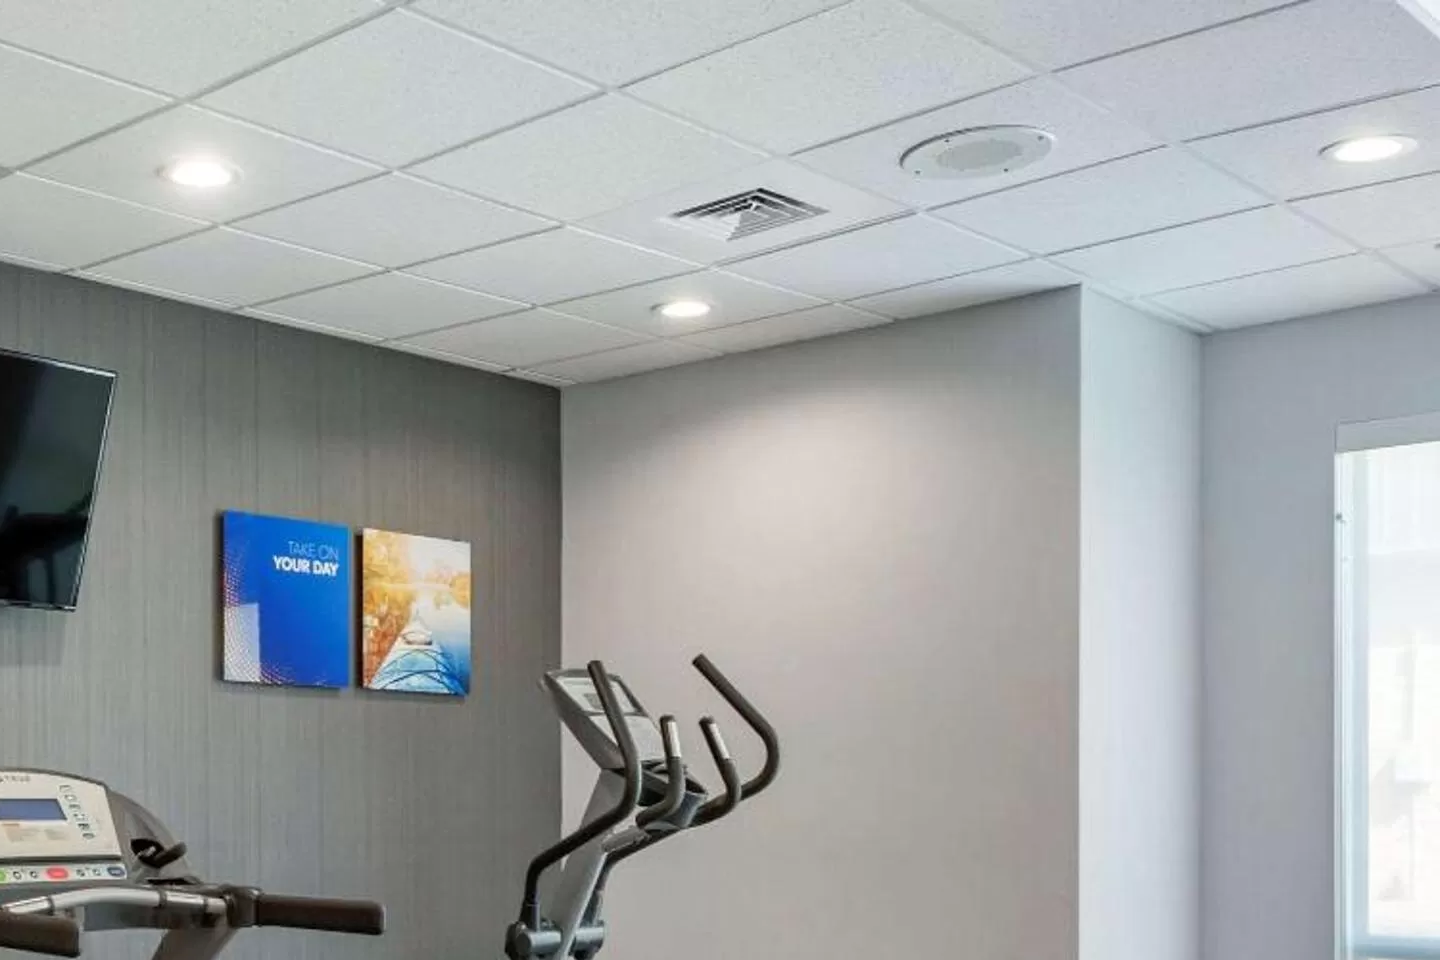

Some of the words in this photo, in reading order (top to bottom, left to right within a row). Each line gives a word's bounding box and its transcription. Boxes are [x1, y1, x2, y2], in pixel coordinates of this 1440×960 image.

[288, 541, 316, 558] TAKE
[318, 544, 339, 560] ON
[272, 555, 311, 574] YOUR
[312, 559, 339, 576] DAY
